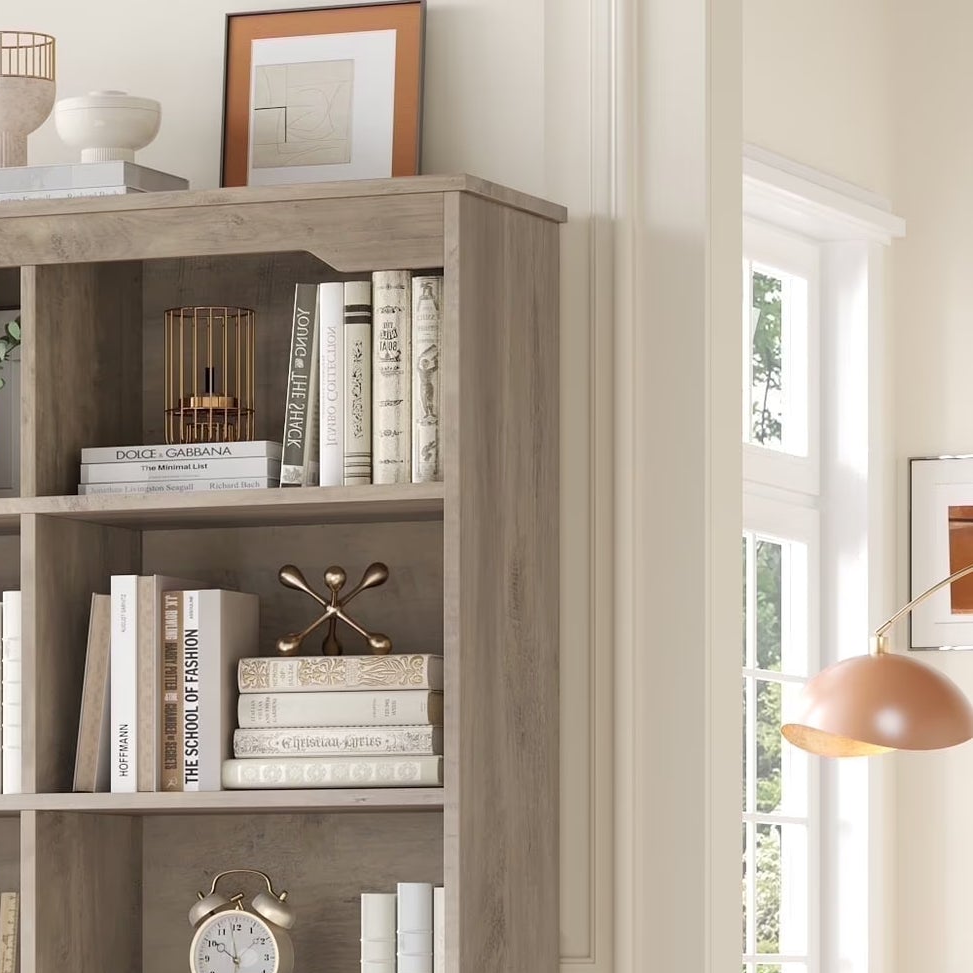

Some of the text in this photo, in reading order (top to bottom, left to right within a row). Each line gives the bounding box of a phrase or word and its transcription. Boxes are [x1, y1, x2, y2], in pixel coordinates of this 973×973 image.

[116, 449, 157, 460] DOLCE
[165, 446, 232, 458] GABBANA
[157, 463, 191, 471] Minimal
[209, 481, 239, 490] Richard
[240, 480, 260, 488] Bach
[165, 594, 178, 609] J.K.
[165, 610, 178, 640] ROWLING
[165, 642, 178, 664] HARRY
[165, 666, 178, 691] POTTER
[185, 629, 199, 784] THE SCHOOL OF FASHION
[165, 703, 177, 735] CHAMBER
[119, 723, 129, 777] HOFFMANN
[165, 741, 177, 770] SECRETS
[208, 940, 217, 948] 10
